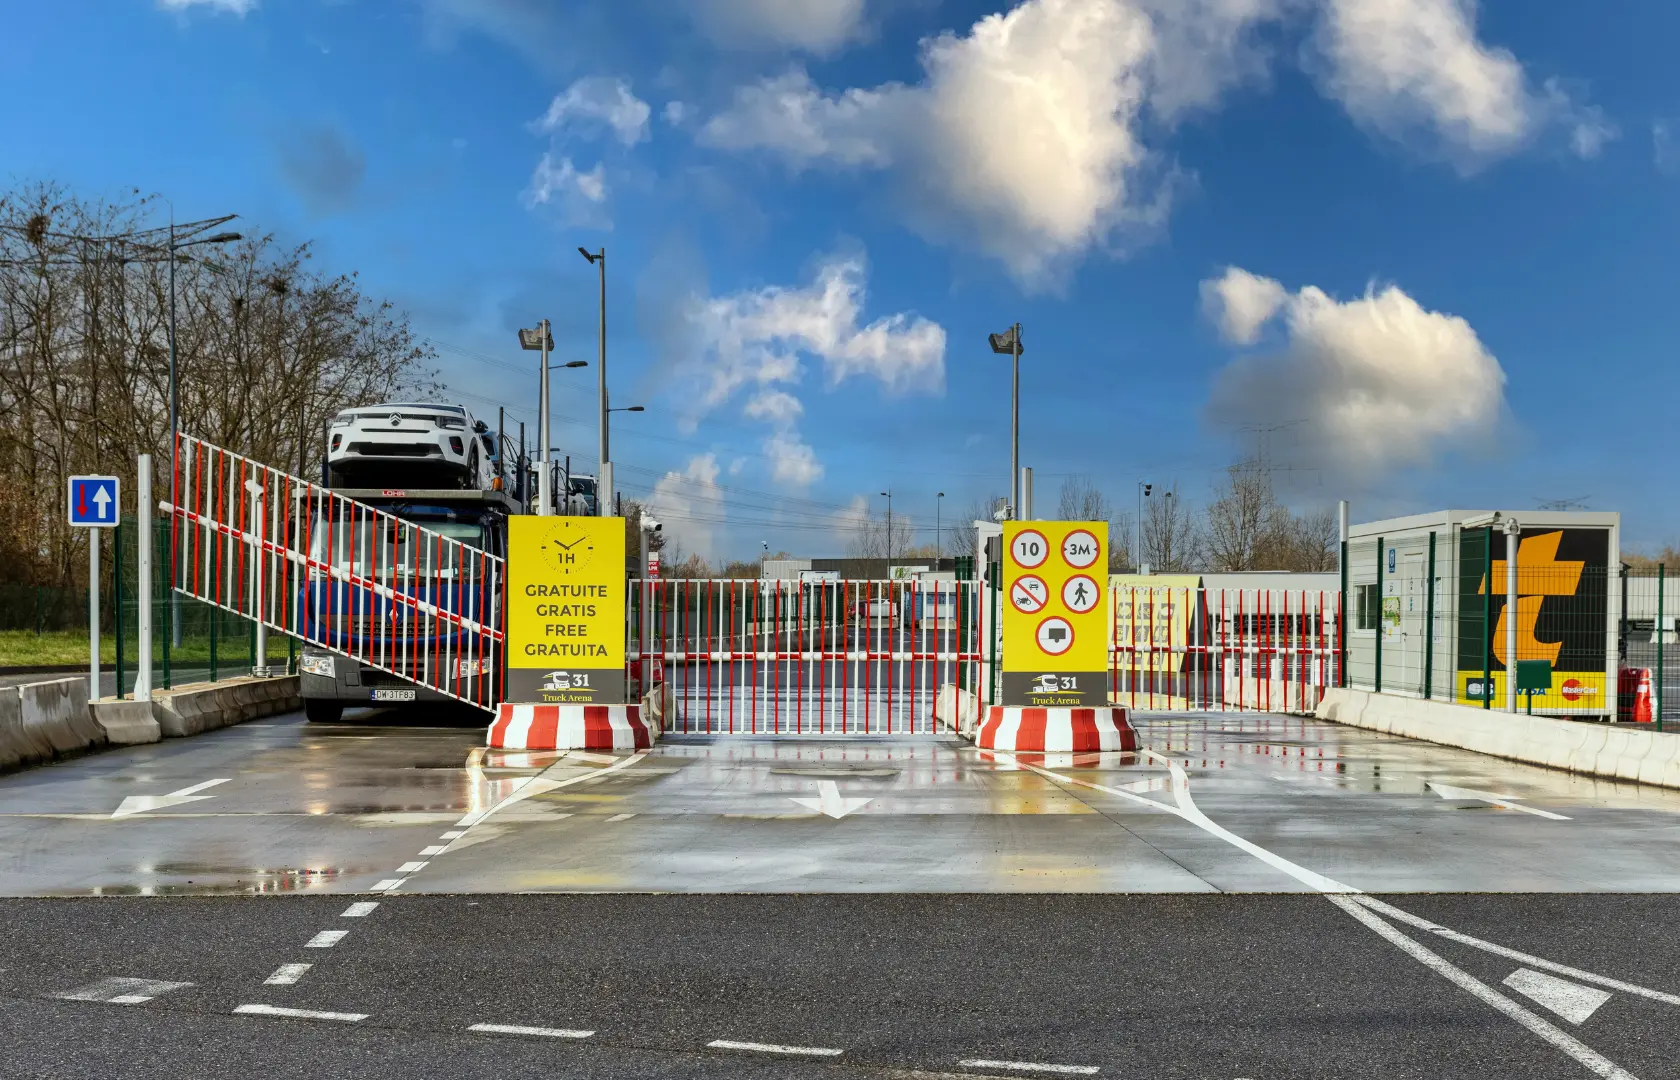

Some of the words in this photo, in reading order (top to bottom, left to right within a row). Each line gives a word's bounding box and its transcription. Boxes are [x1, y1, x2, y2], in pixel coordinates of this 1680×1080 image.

[1020, 543, 1039, 556] 10
[1069, 543, 1091, 556] 3M
[558, 553, 575, 564] 1H
[525, 584, 608, 598] GRATUITE
[536, 604, 596, 617] GRATIS
[545, 624, 587, 637] FREE
[524, 644, 608, 657] GRATUITA
[572, 674, 590, 687] 31
[1060, 676, 1078, 690] 31
[376, 691, 387, 699] DW
[542, 693, 567, 702] Truck
[567, 694, 593, 702] Arena
[1031, 696, 1056, 705] Truck
[1056, 697, 1081, 705] Arena
